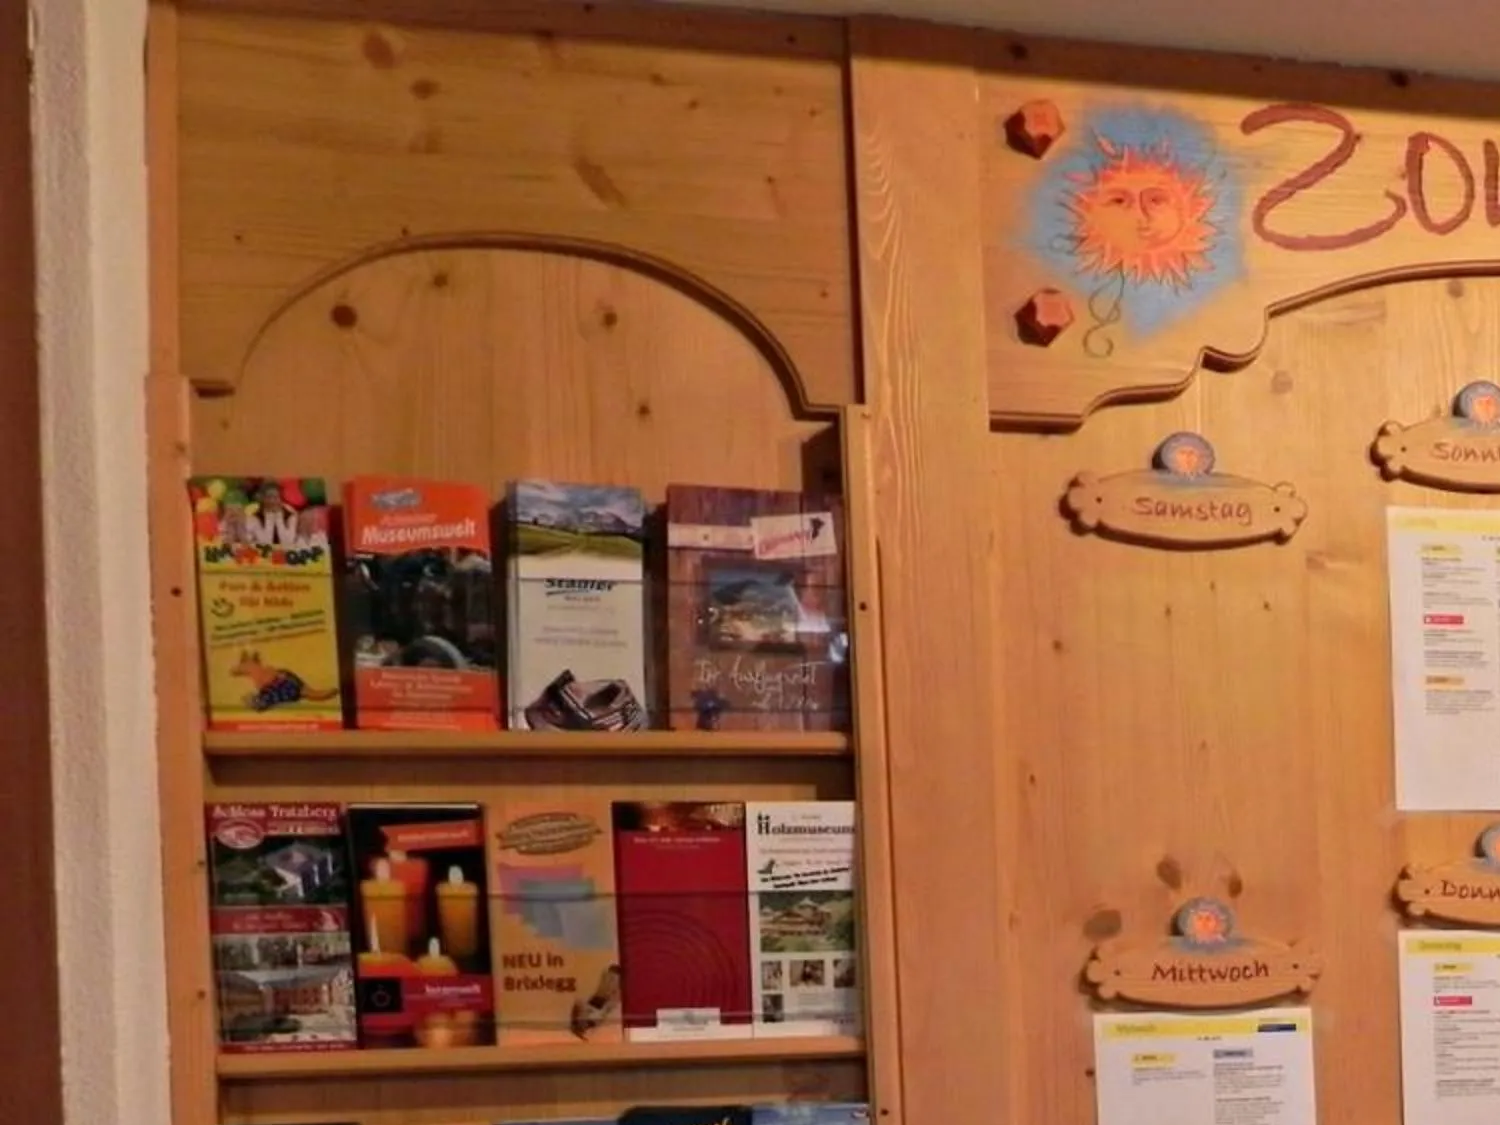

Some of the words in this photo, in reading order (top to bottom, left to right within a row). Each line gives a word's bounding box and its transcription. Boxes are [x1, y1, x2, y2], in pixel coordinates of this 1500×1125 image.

[1132, 496, 1252, 526] Samstag
[362, 518, 476, 545] Museumswelt
[503, 953, 541, 969] NEU
[546, 952, 564, 968] in
[1151, 960, 1270, 982] Mittwoch
[503, 975, 577, 993] Brixlegg
